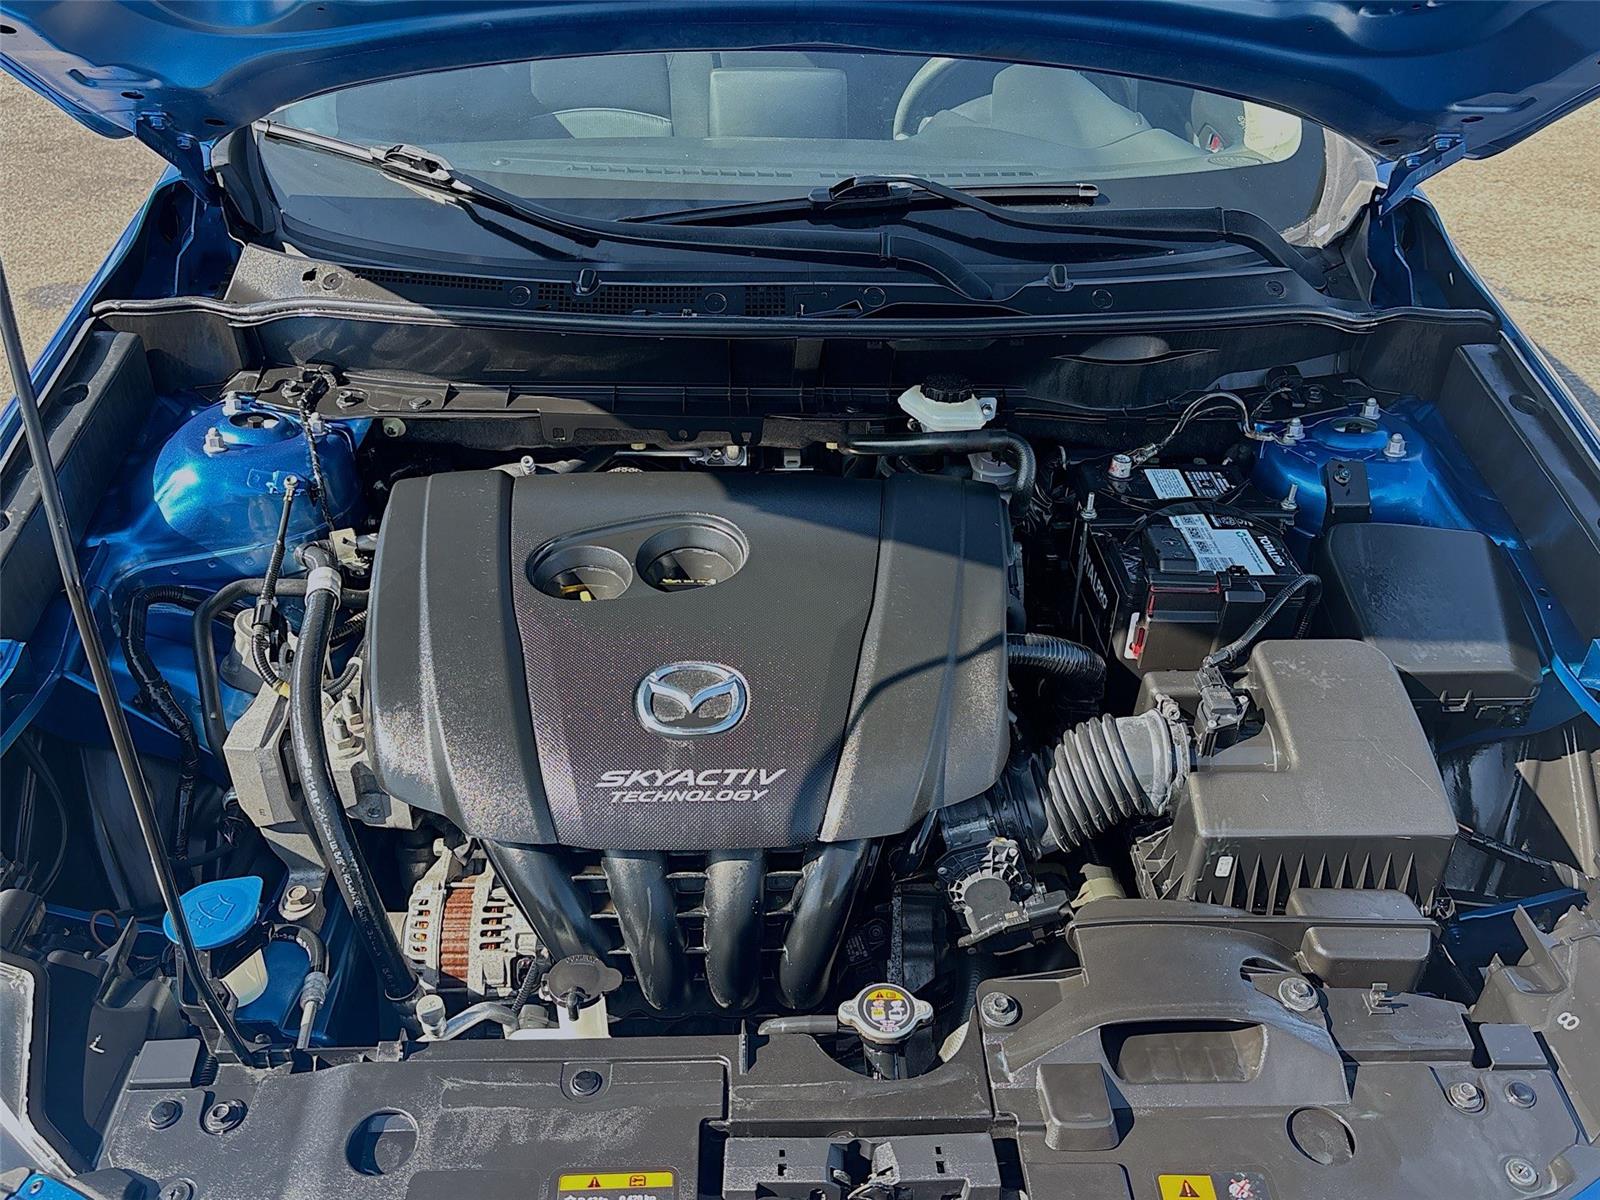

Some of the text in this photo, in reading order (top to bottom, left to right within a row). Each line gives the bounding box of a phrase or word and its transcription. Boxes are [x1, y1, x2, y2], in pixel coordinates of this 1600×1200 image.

[1257, 535, 1286, 567] TOTALPRO
[595, 768, 787, 788] SKYACTIV
[610, 788, 770, 803] TECHNOLOGY
